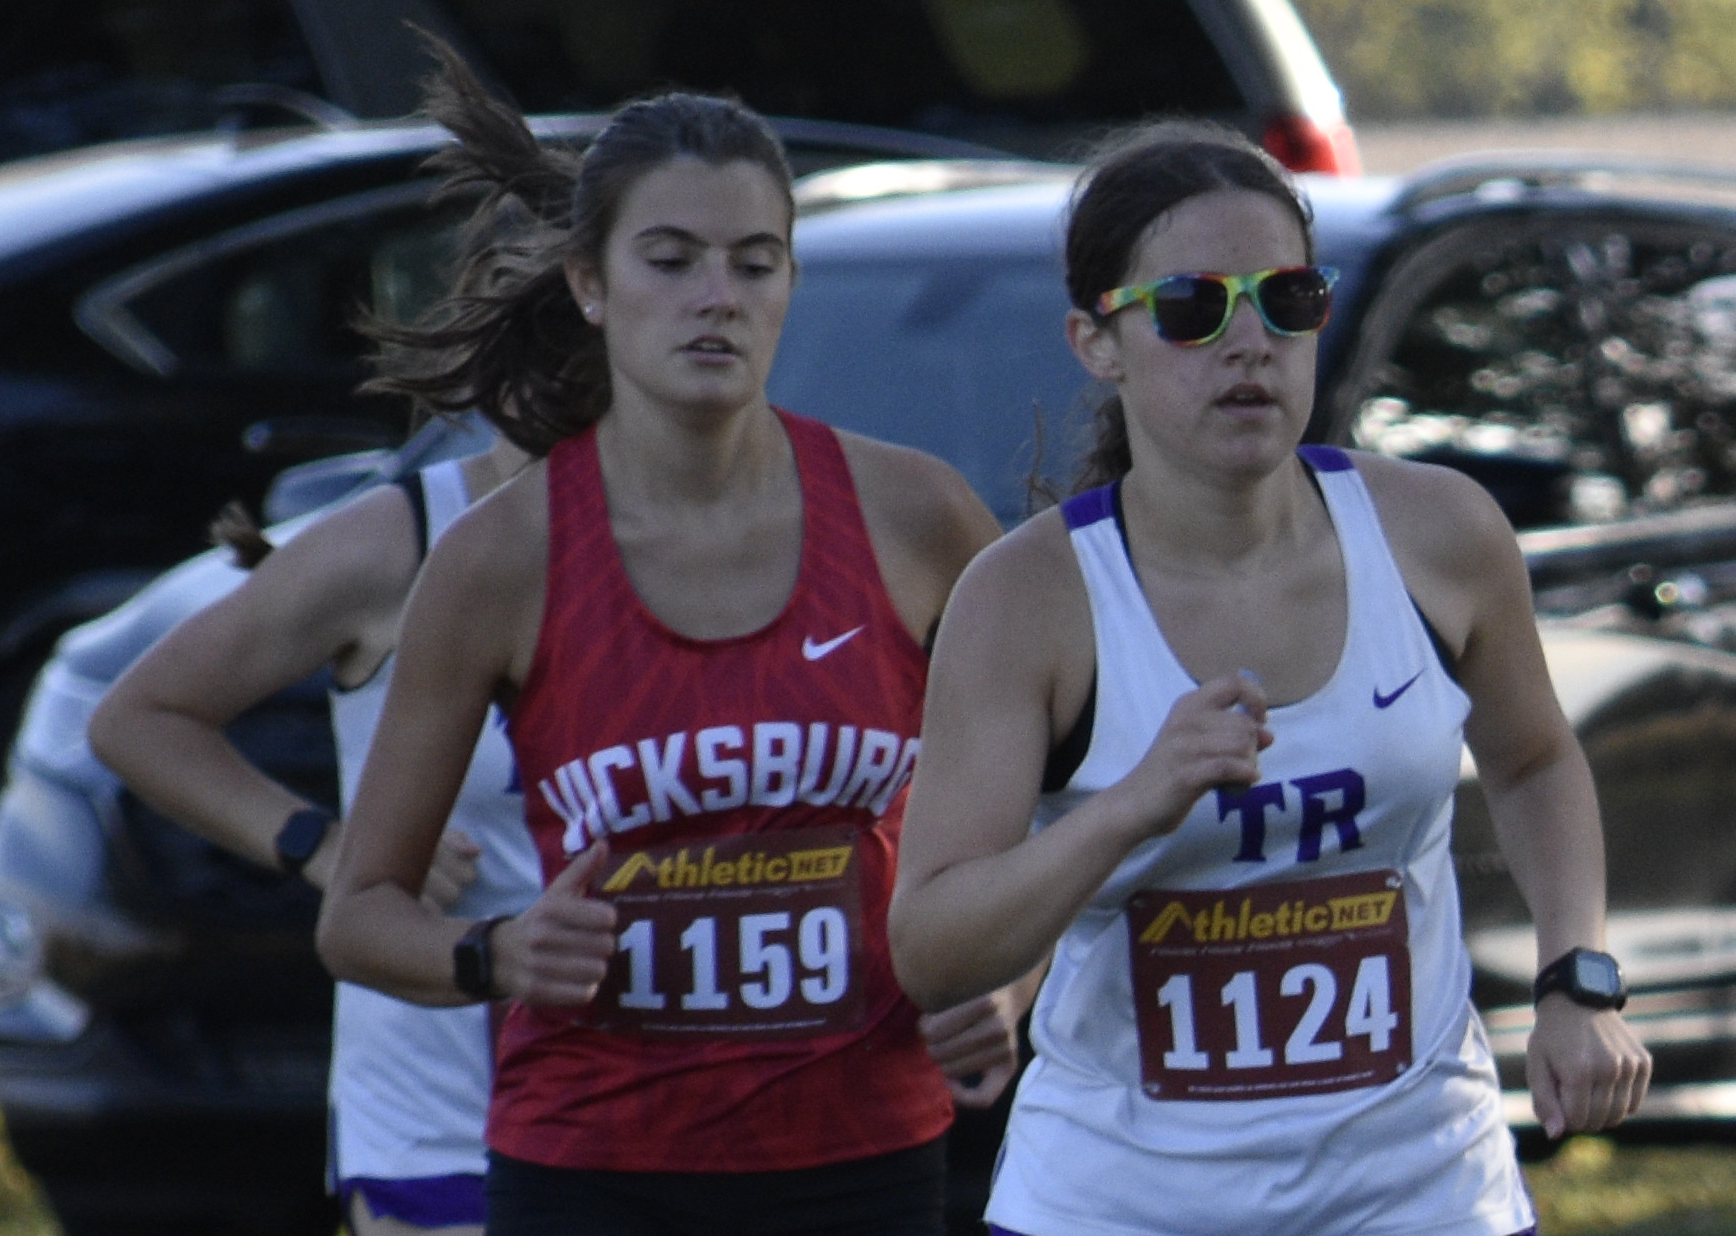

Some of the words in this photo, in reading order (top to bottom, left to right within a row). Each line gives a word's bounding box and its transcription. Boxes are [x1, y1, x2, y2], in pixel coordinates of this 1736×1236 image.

[1215, 767, 1366, 863] TR
[617, 906, 849, 1010] 1159
[1157, 954, 1399, 1070] 1124
